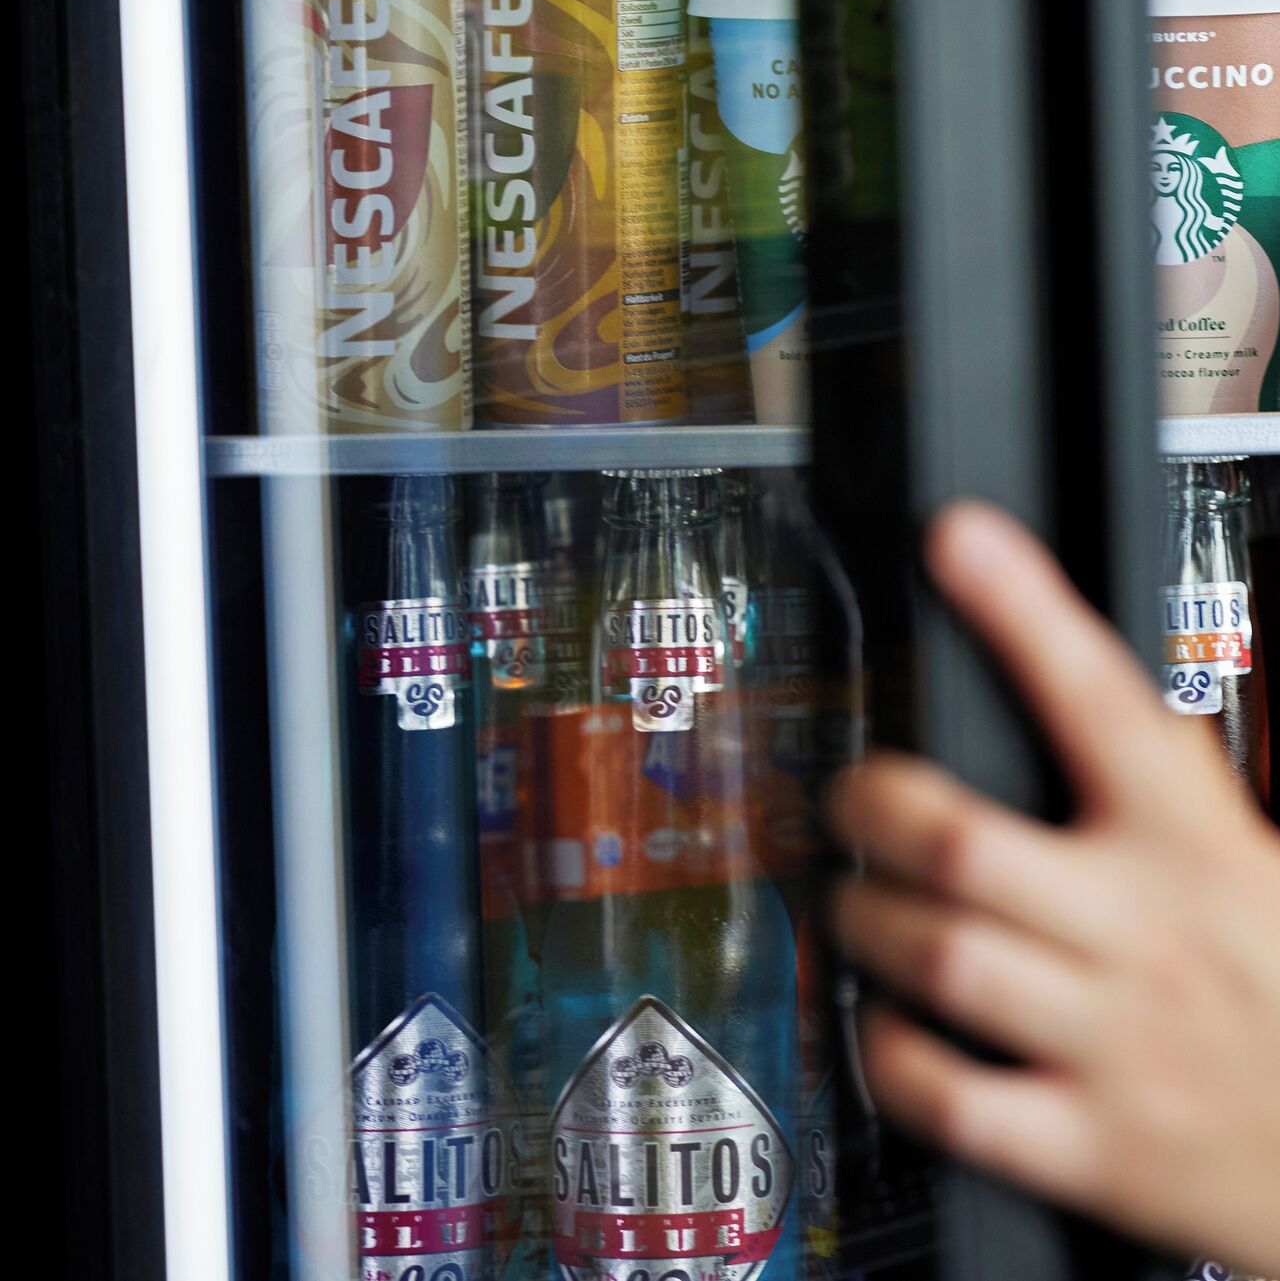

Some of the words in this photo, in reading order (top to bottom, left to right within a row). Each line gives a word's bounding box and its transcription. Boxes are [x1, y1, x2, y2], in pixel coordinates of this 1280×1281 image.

[1148, 62, 1274, 90] UCCINO
[752, 82, 780, 100] NO
[1178, 317, 1226, 332] Coffee
[1184, 349, 1230, 360] Creamy
[1232, 347, 1259, 358] milk
[1198, 367, 1241, 378] flavour
[1166, 598, 1241, 630] LITOS
[364, 609, 467, 645] SALITOS
[607, 612, 715, 645] SALITOS
[1174, 640, 1243, 660] RITZ
[552, 1131, 775, 1208] SALITOS
